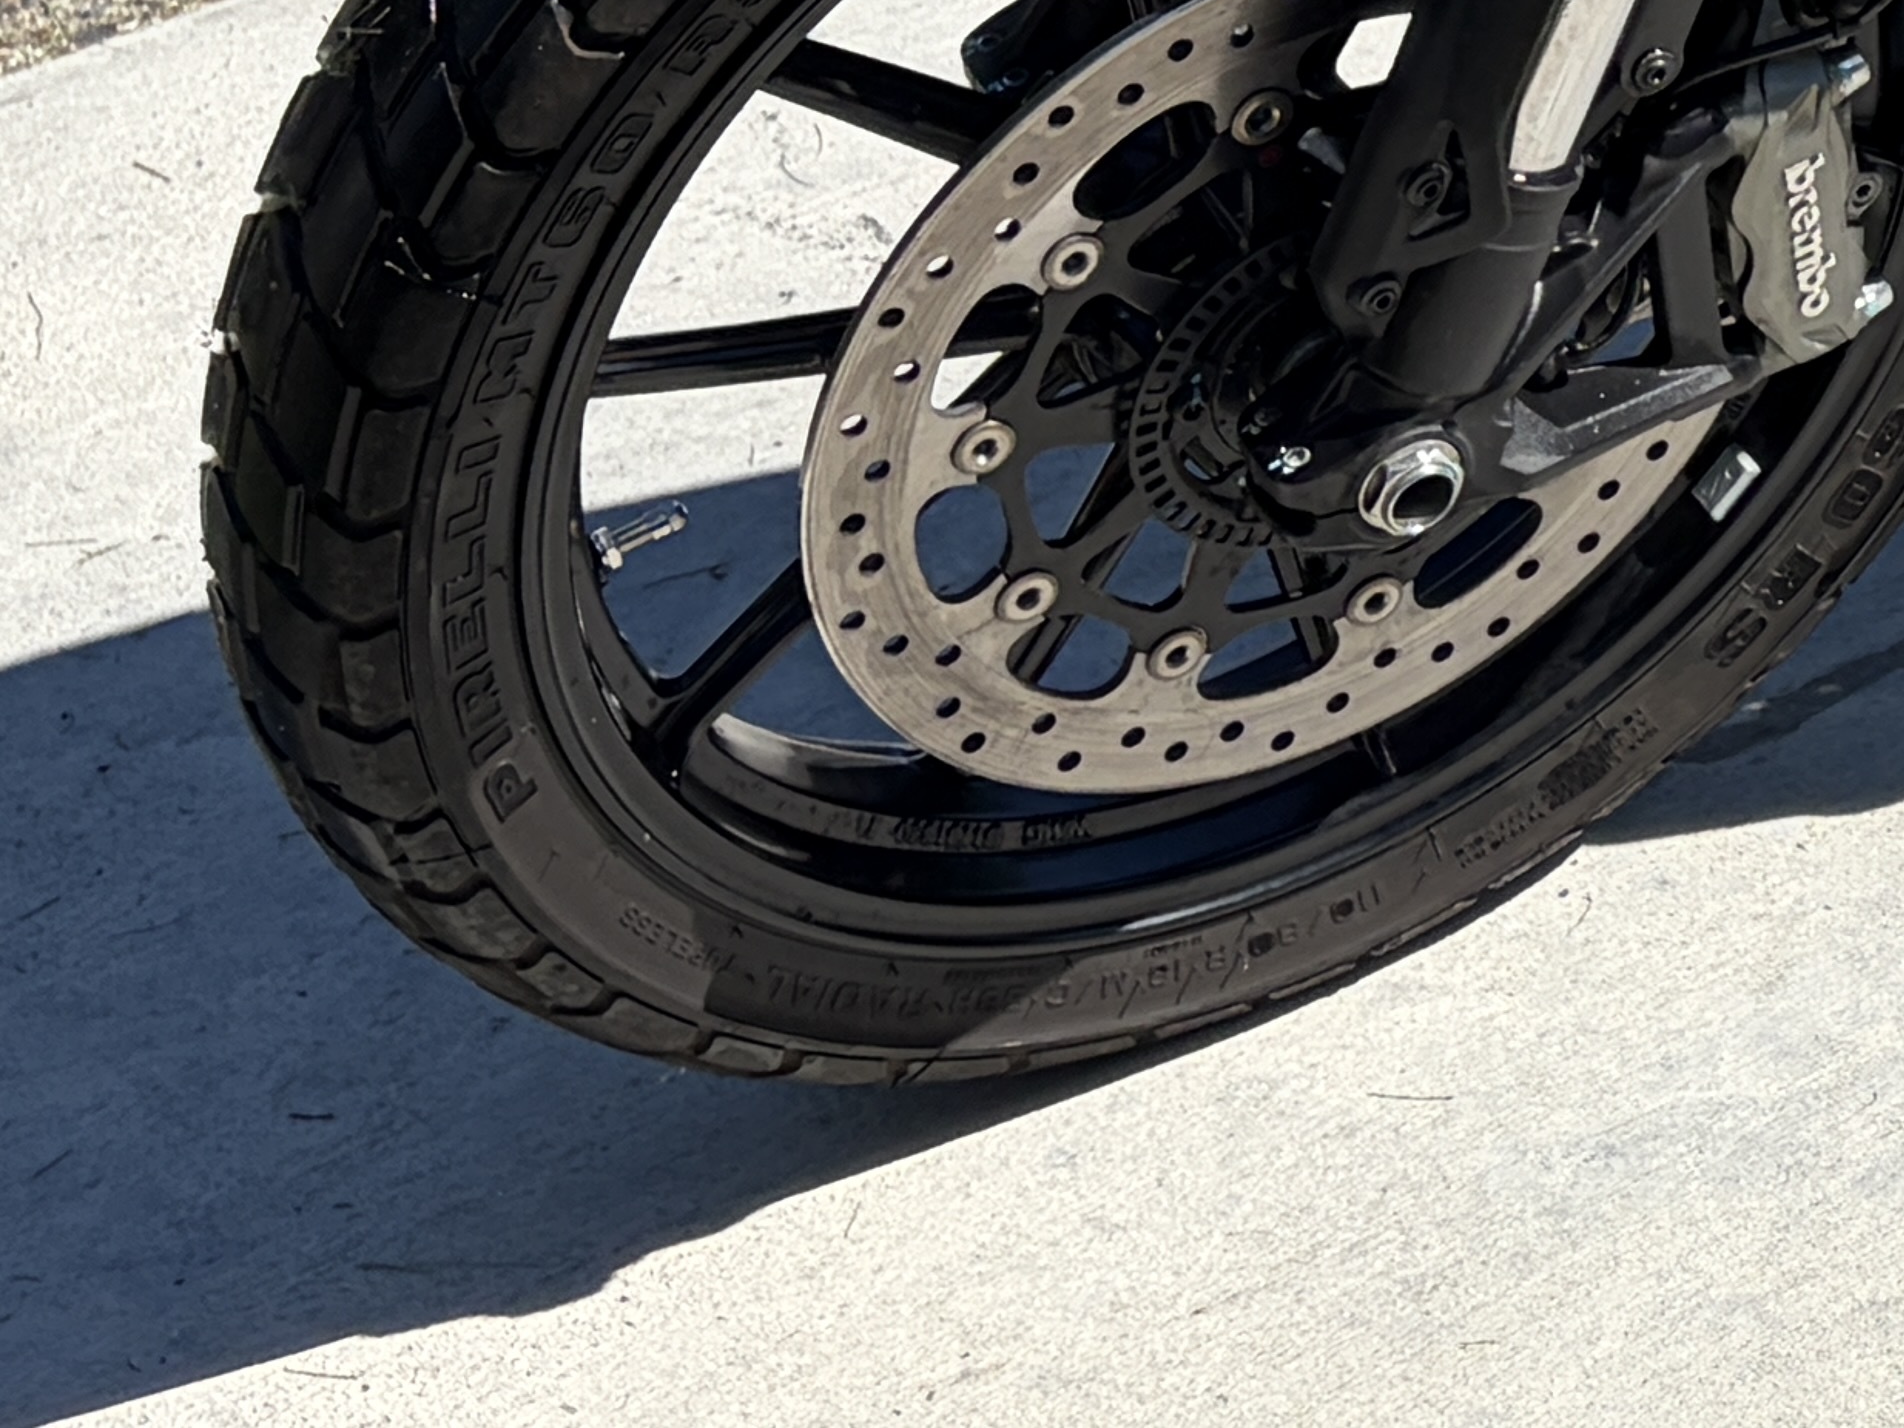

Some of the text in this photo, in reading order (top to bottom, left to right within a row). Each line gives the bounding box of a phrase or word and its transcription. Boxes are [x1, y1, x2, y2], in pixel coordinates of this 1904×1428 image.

[473, 113, 655, 404] MT60
[1783, 152, 1837, 318] brembo
[442, 433, 538, 824] PIRELLI
[1703, 542, 1823, 668] RS
